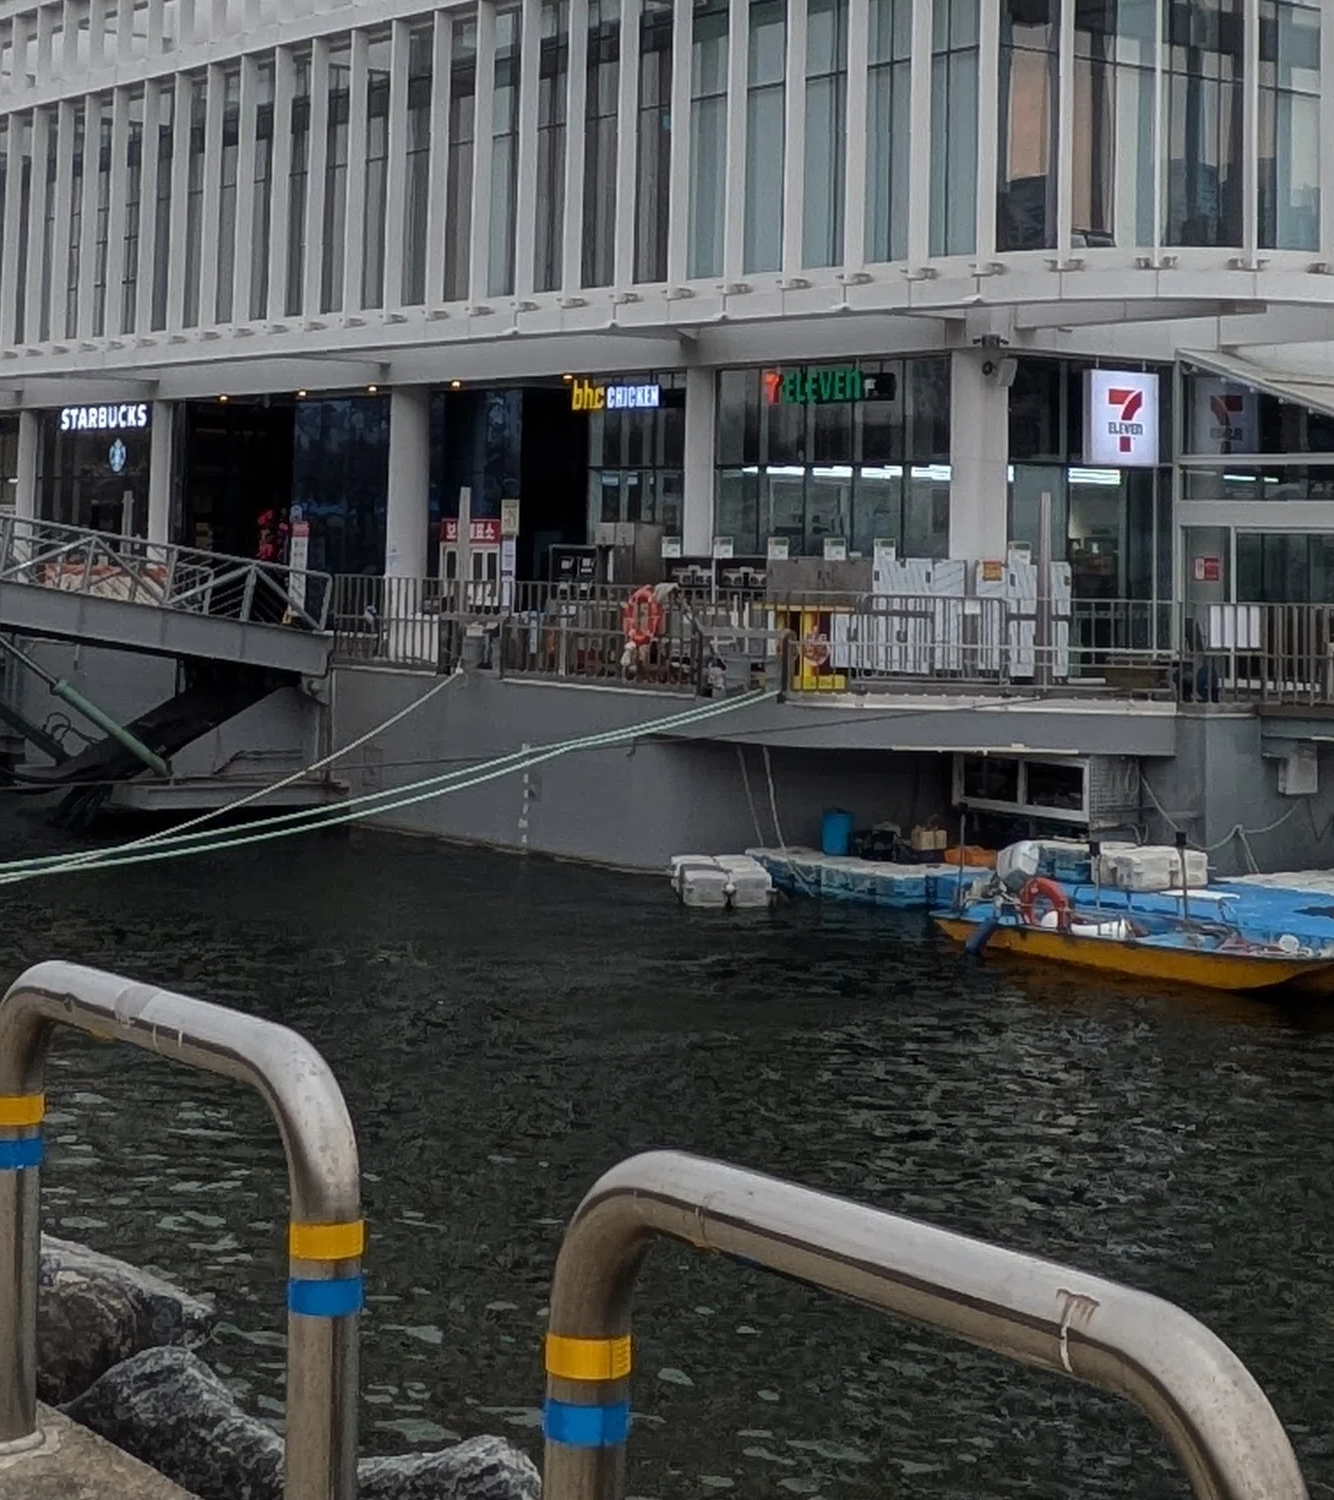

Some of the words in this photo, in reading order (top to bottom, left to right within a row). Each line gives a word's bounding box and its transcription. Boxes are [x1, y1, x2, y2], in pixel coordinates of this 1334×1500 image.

[572, 380, 605, 411] bhc
[607, 385, 659, 408] CHICKEN
[60, 404, 147, 431] STARBUCKS
